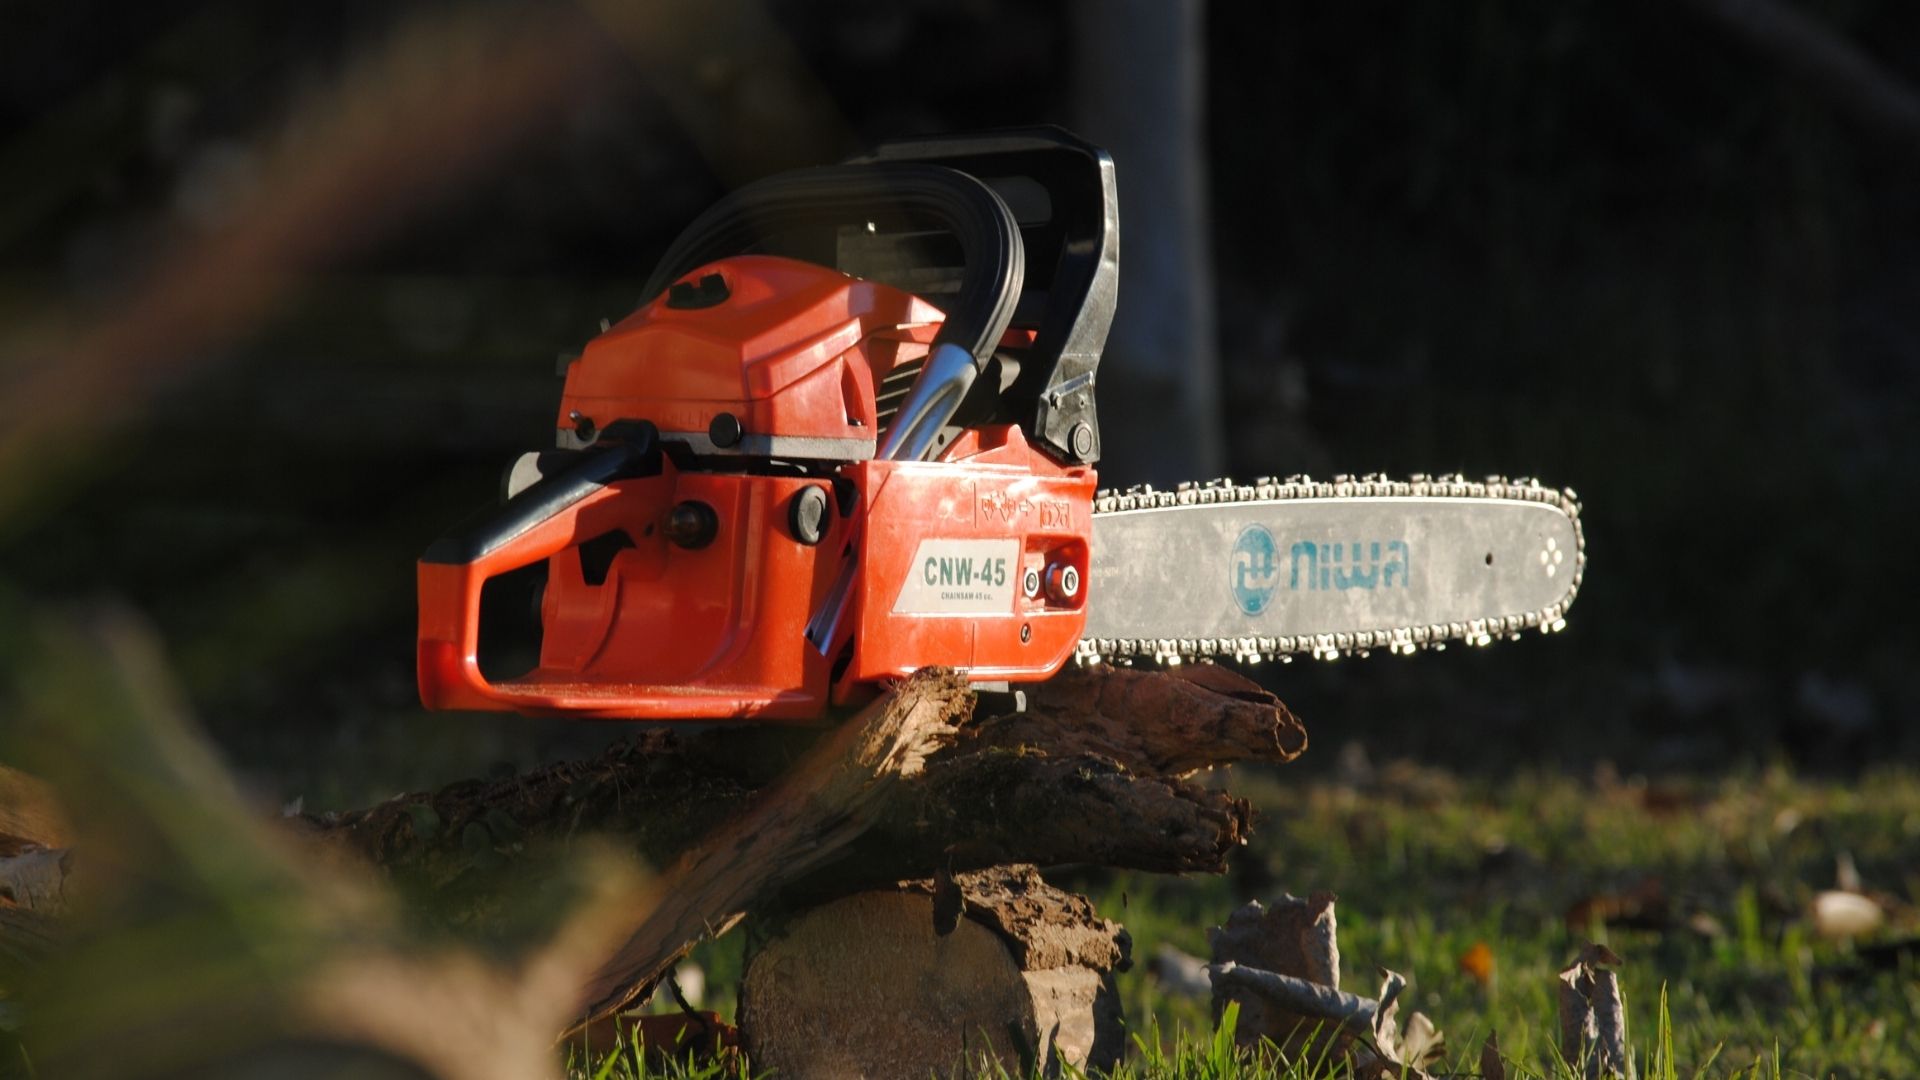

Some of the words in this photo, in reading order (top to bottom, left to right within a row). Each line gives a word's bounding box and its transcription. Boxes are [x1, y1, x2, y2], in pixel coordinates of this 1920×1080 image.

[924, 556, 1006, 587] CNW-45
[1290, 540, 1409, 591] niwa
[941, 591, 974, 600] CHAINSAW
[975, 591, 983, 600] 45
